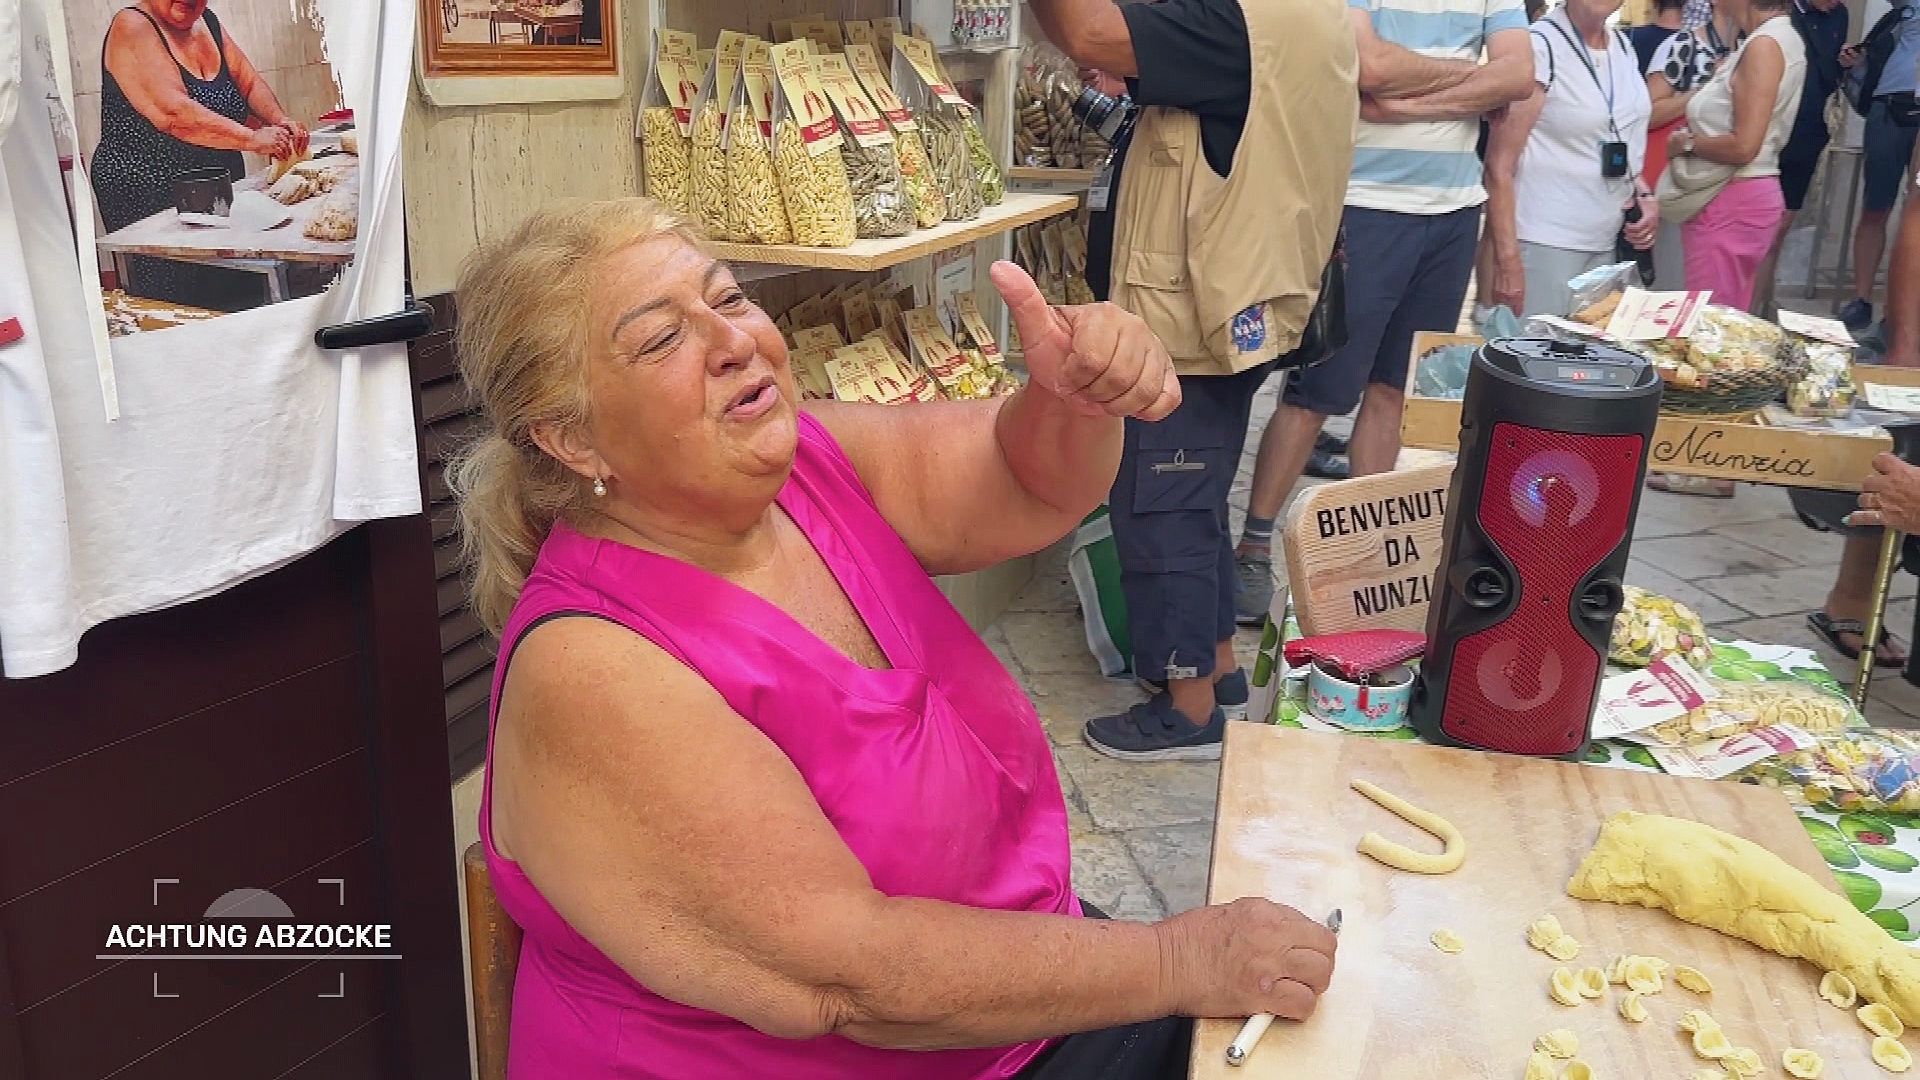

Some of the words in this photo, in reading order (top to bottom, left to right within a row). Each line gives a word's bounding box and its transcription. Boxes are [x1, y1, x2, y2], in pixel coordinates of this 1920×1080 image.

[1316, 488, 1449, 540] BENVENUT
[1384, 534, 1420, 567] DA
[1352, 574, 1432, 617] NUNZI
